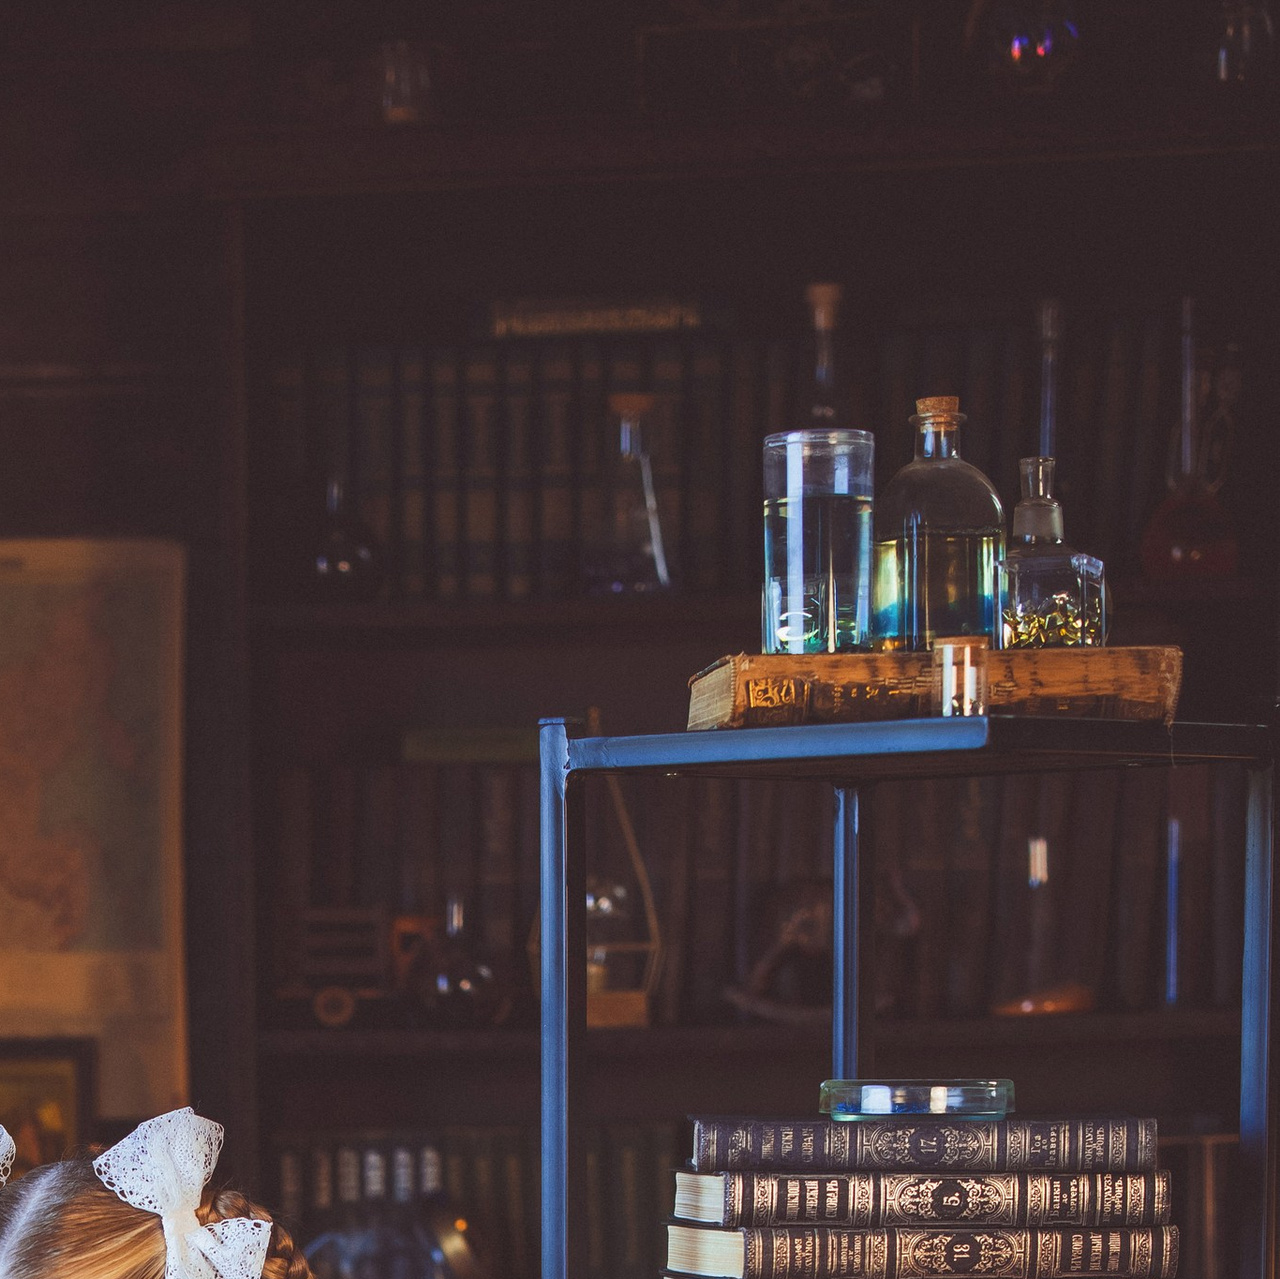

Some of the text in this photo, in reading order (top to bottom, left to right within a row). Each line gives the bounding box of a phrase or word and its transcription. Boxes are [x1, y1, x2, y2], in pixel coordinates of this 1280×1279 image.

[919, 1136, 937, 1156] 17.
[1030, 1134, 1041, 1154] Гоа
[1045, 1124, 1058, 1166] Граверъ
[825, 1180, 839, 1218] СЛОВАРЬ
[942, 1191, 961, 1209] 5.
[1050, 1180, 1060, 1217] Банки
[953, 1243, 970, 1262] 31.
[1071, 1234, 1083, 1271] СЛОВАРЬ
